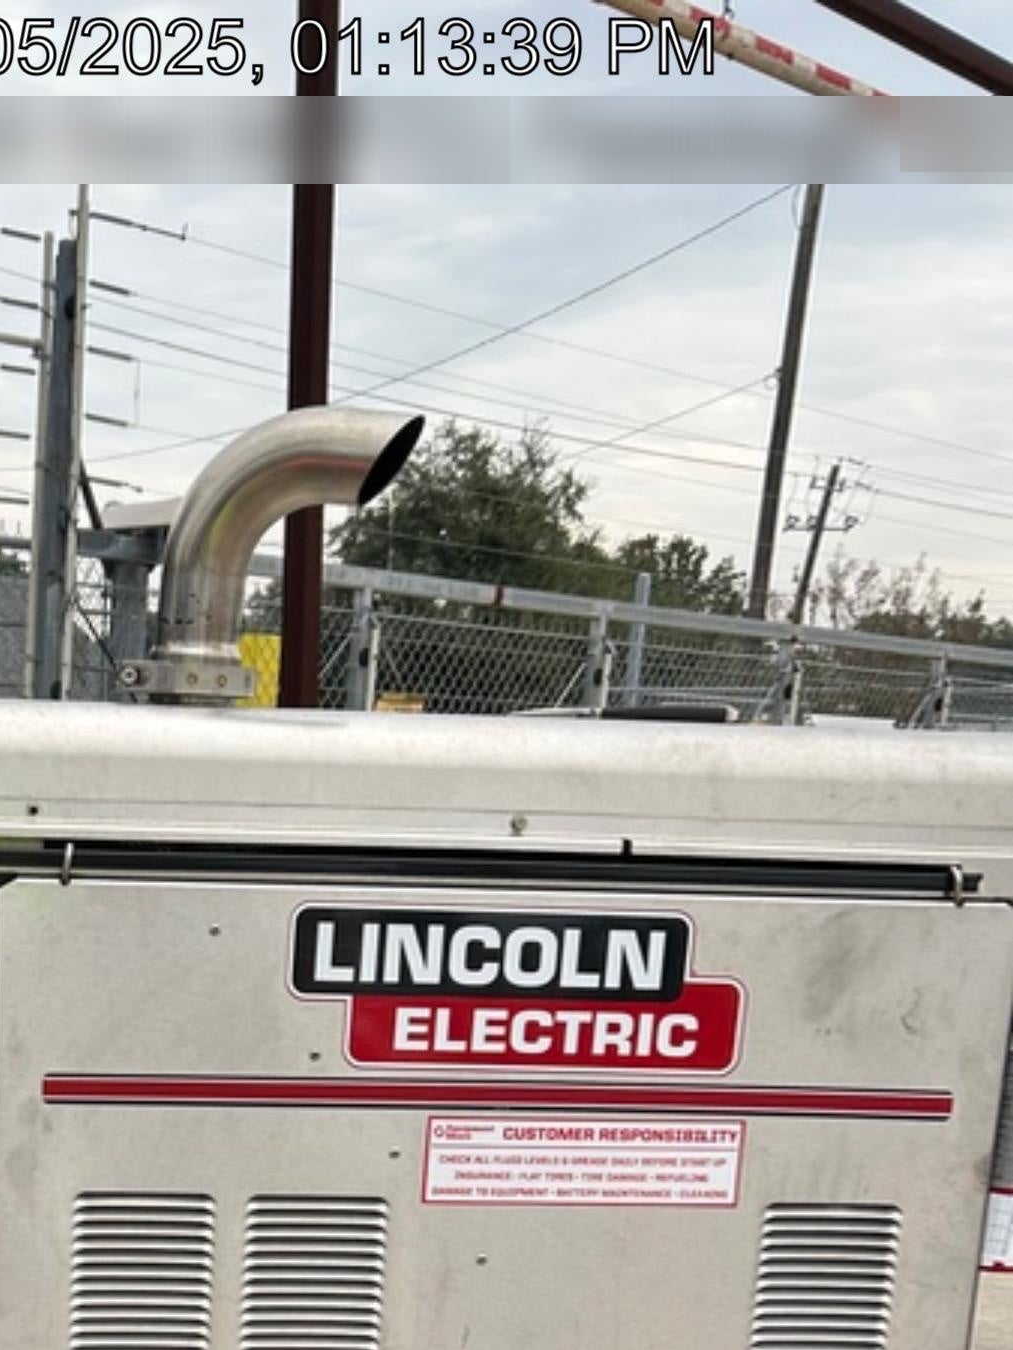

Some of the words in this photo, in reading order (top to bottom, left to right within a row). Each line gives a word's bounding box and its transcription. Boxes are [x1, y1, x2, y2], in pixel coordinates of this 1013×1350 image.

[313, 920, 667, 991] LINCOLN
[392, 1005, 700, 1059] ELECTRIC
[502, 1126, 595, 1142] CUSTOMER
[598, 1128, 737, 1144] RESPONSIBILITY
[438, 1154, 472, 1165] CHECK
